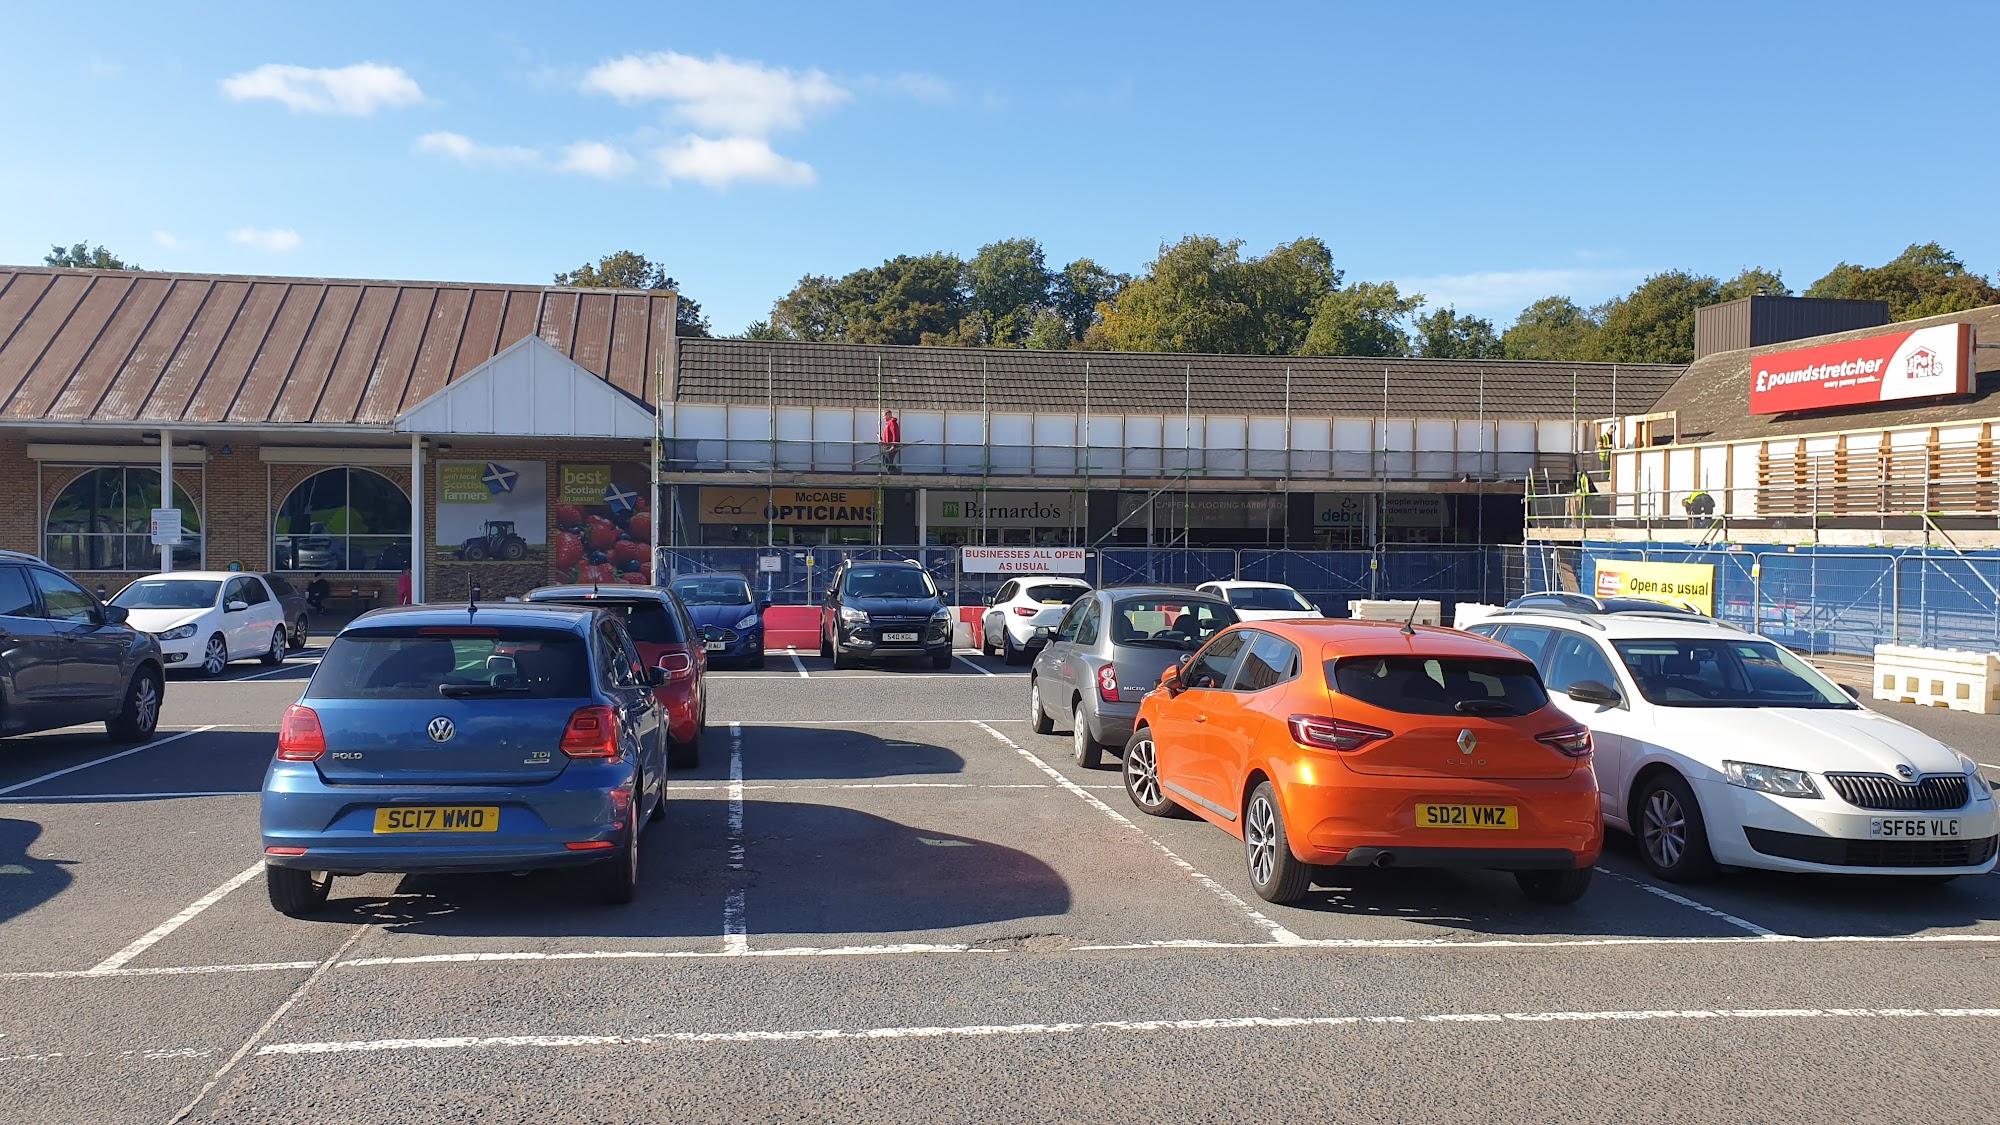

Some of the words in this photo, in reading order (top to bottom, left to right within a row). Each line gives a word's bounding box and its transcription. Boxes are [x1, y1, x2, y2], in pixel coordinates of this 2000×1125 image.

[564, 467, 603, 485] best
[444, 480, 486, 489] Scottish
[564, 485, 607, 494] Scotland
[444, 489, 488, 500] farmers
[795, 492, 847, 502] McCABE
[1190, 501, 1196, 509] &
[1198, 501, 1239, 509] FLOORING
[1412, 497, 1439, 506] whose
[763, 505, 877, 521] OPTICIANS
[964, 501, 1061, 519] Barnardo's
[965, 550, 1030, 559] BUSINESSES
[1033, 550, 1052, 559] ALL
[1054, 550, 1082, 559] OPEN
[998, 562, 1012, 571] AS
[1015, 562, 1050, 571] USUAL
[1630, 578, 1658, 594] Open
[1661, 583, 1674, 594] as
[1677, 582, 1709, 596] usual
[332, 752, 363, 760] POLO
[1446, 758, 1487, 766] CLIO
[388, 810, 436, 828] SC17
[443, 809, 484, 828] WMO
[1427, 806, 1467, 824] SD21
[1472, 807, 1506, 825] VMZ
[1883, 820, 1926, 836] SF65
